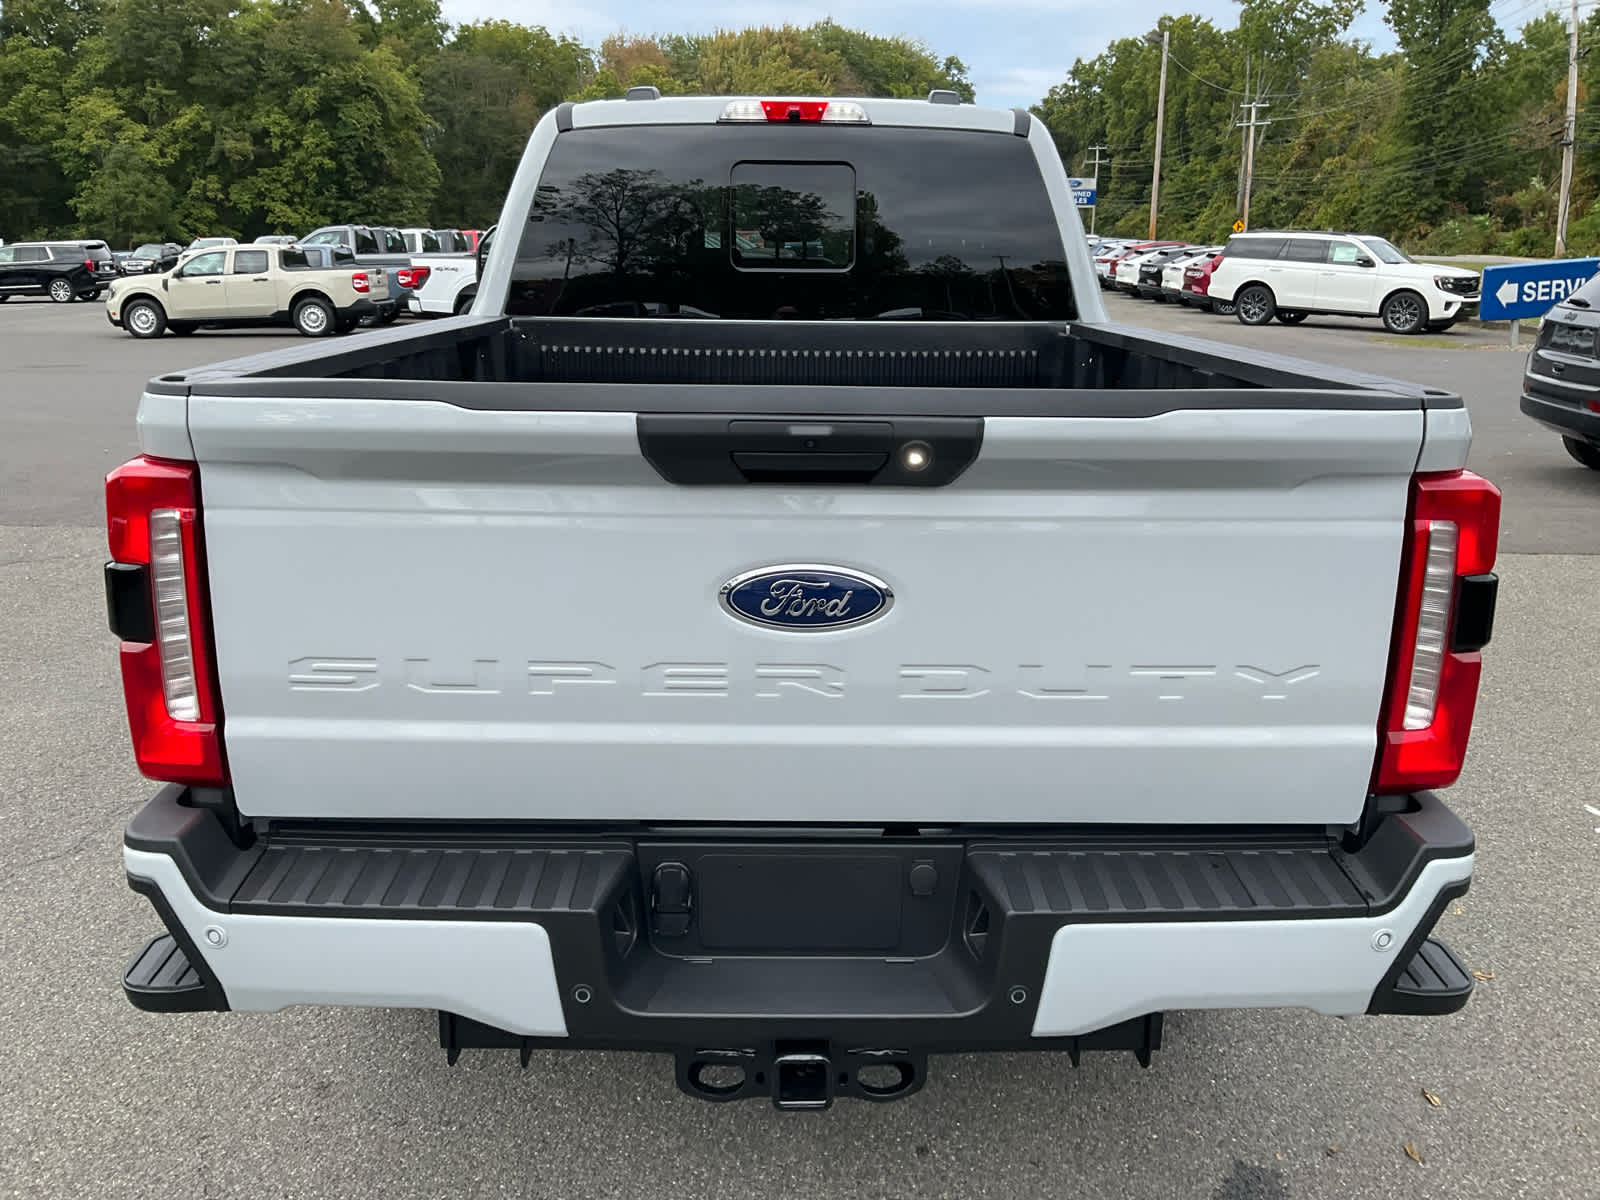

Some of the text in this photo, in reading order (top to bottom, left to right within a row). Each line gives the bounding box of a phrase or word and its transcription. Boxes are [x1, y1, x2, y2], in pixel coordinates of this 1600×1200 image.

[759, 579, 853, 617] Ford
[287, 656, 1321, 700] SUPER DUTY
